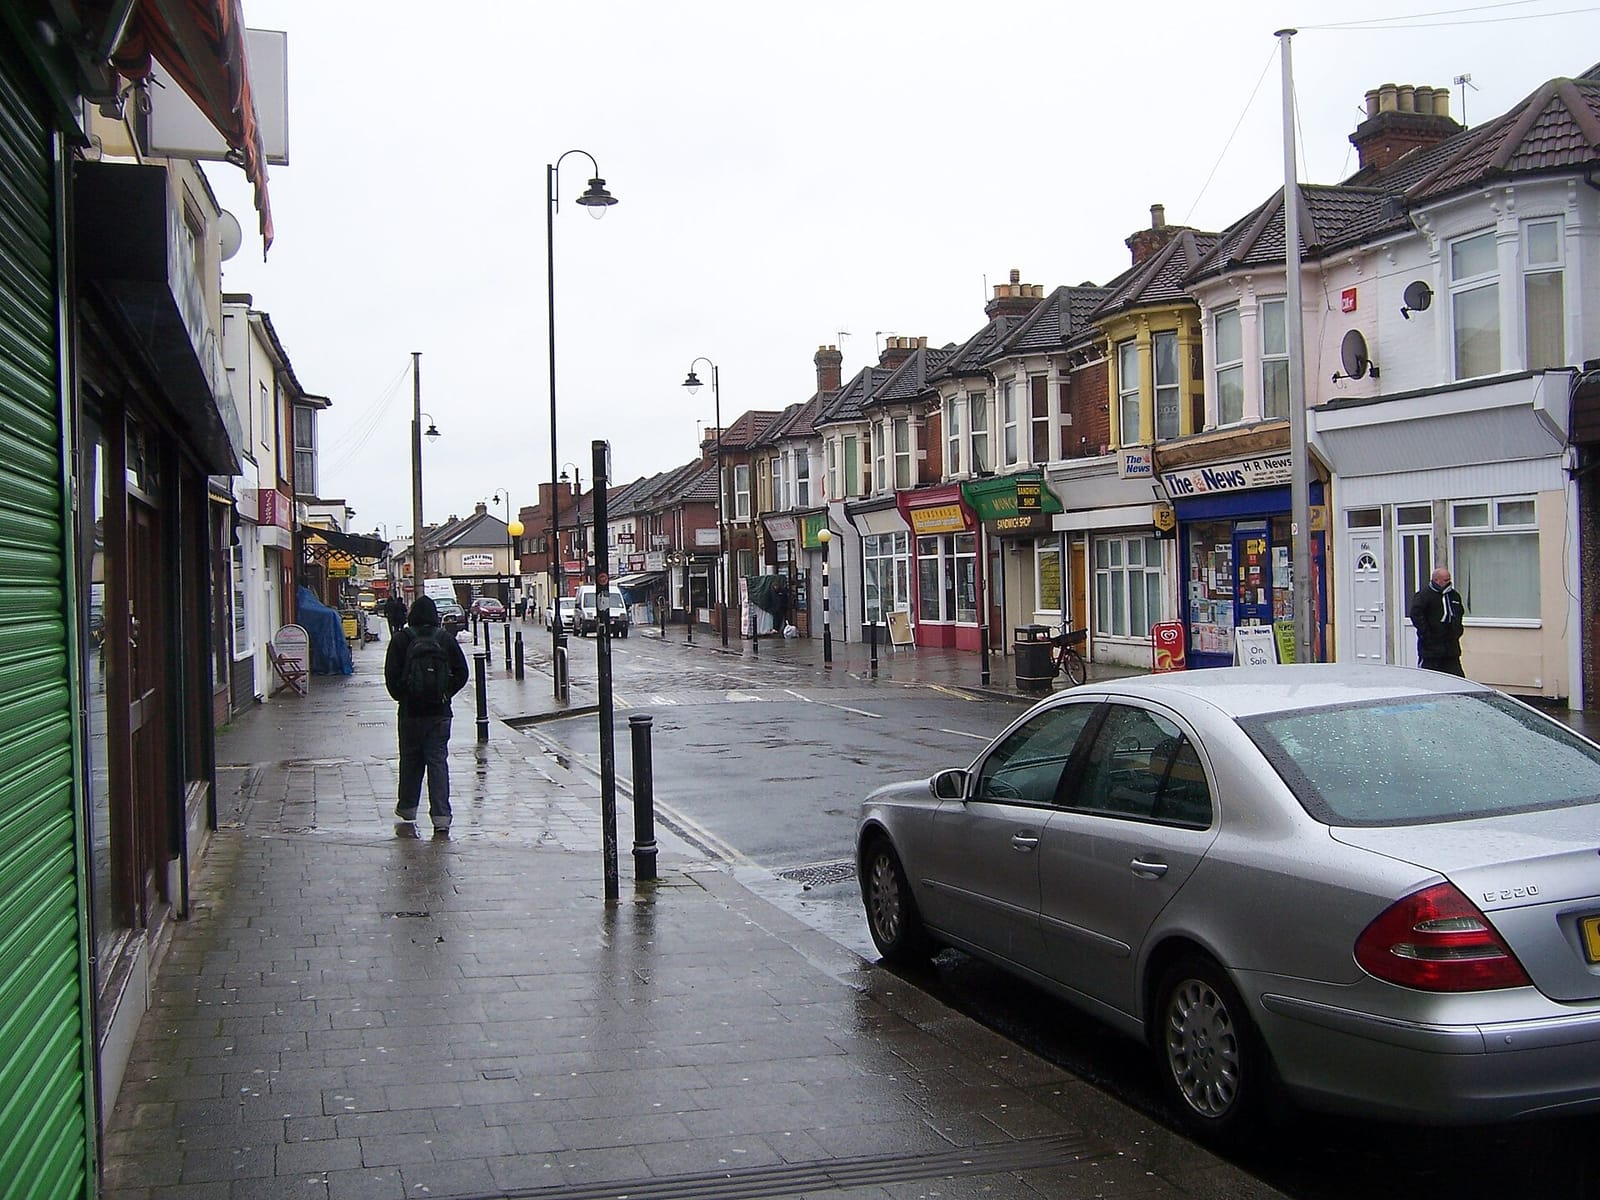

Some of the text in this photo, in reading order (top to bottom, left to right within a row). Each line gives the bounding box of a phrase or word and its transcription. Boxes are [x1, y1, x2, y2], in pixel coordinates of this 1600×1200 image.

[1125, 455, 1142, 464] The
[1126, 463, 1151, 473] News
[1242, 457, 1292, 472] H R News
[1165, 468, 1246, 496] The News
[1017, 487, 1041, 496] SANDWICH
[1023, 497, 1036, 506] SHOP
[996, 515, 1032, 530] SANDWICH SHOP
[1250, 646, 1264, 655] On
[1250, 657, 1267, 666] Sale
